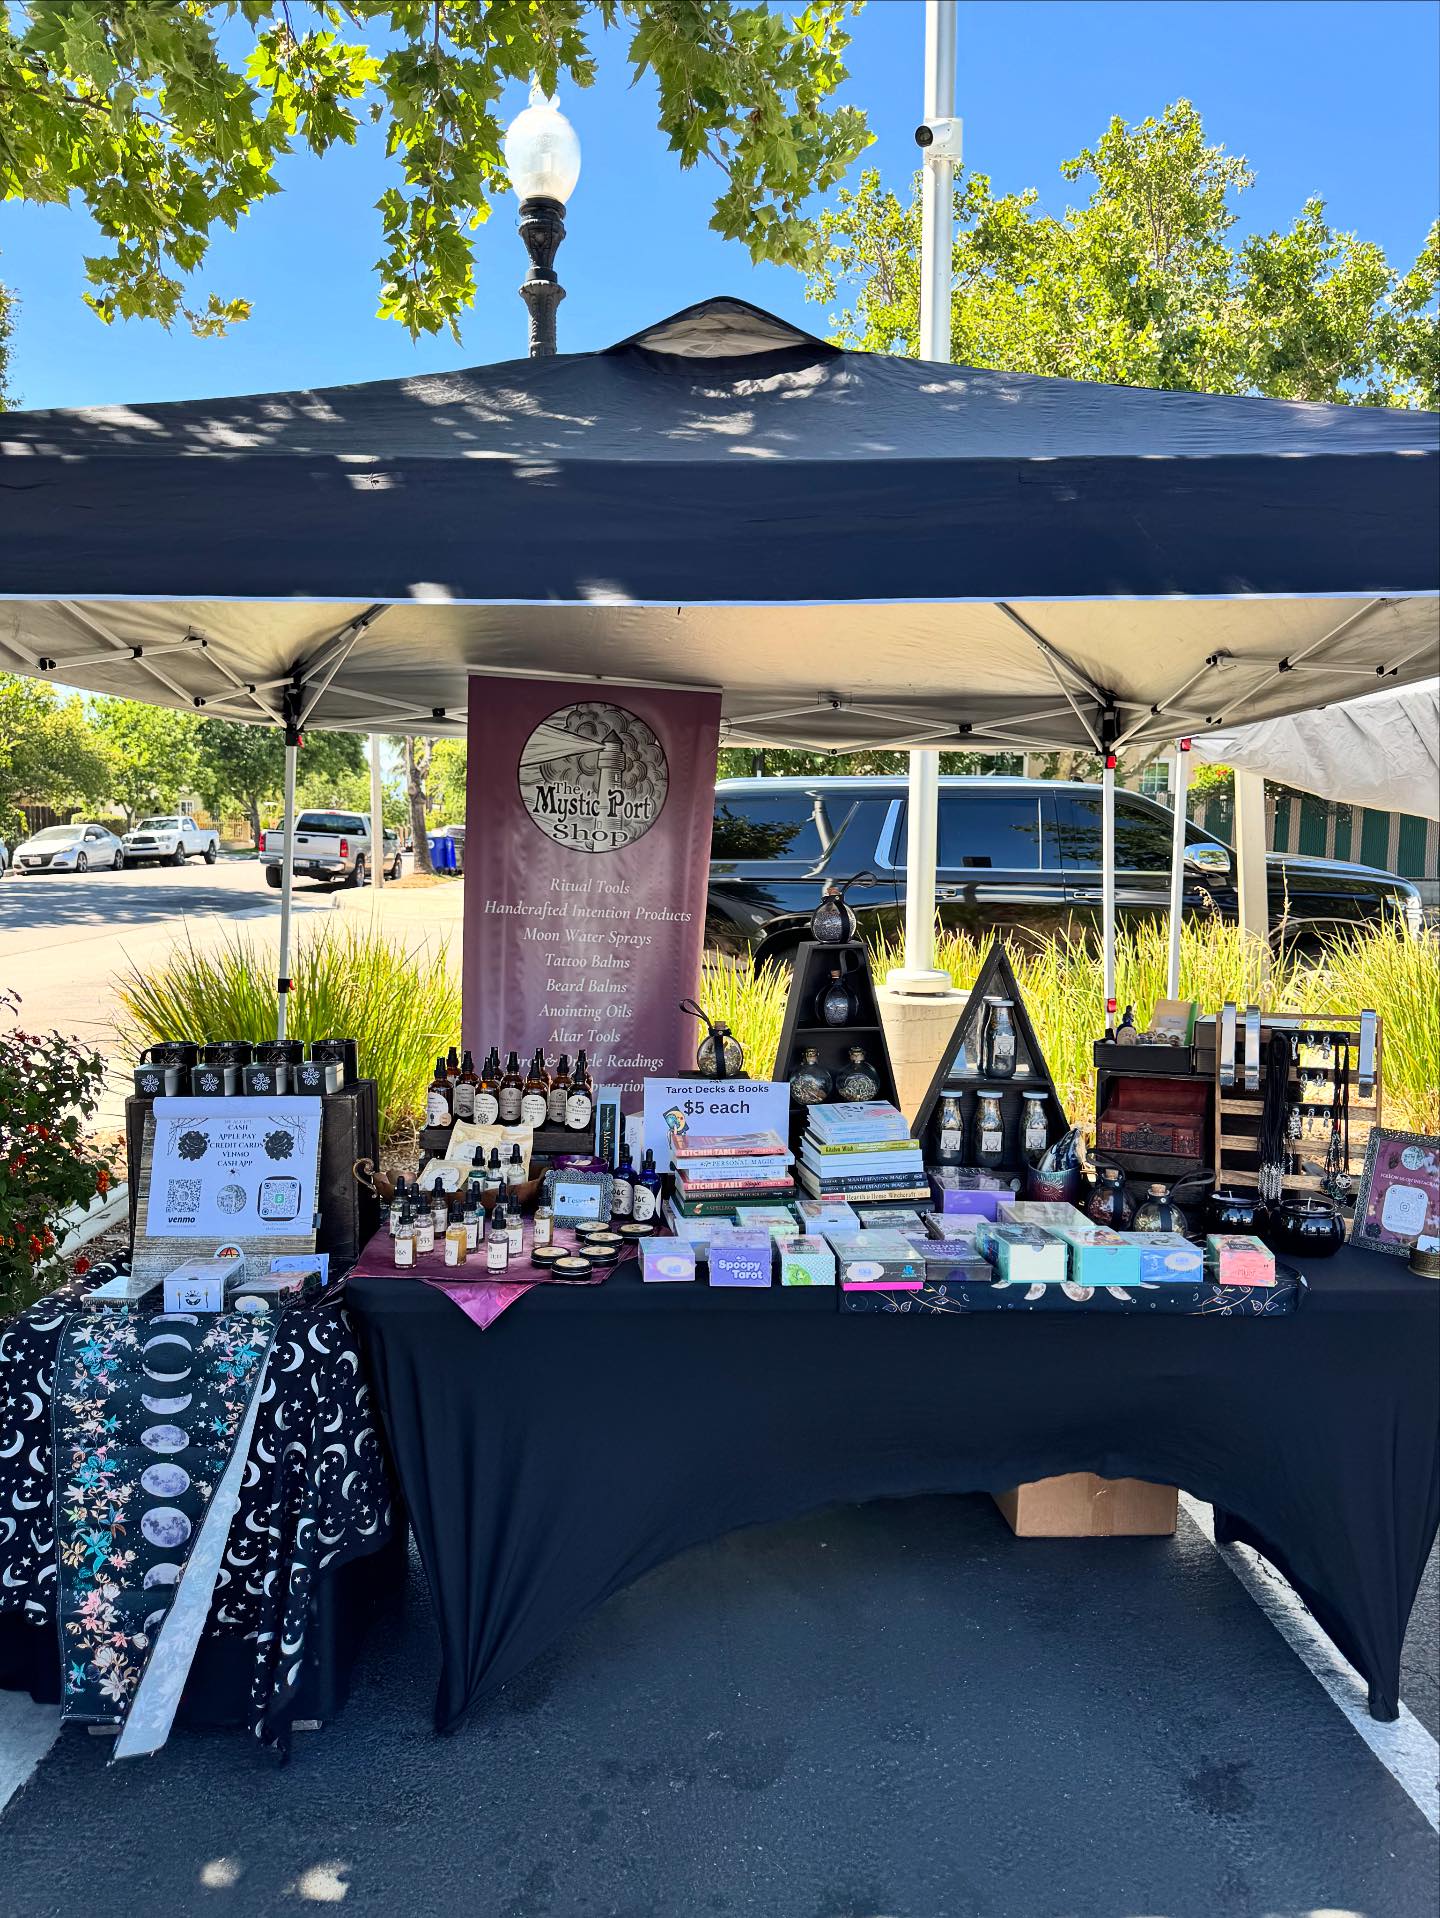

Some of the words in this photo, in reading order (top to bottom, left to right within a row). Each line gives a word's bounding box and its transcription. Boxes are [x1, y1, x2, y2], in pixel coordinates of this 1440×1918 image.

[553, 782, 581, 795] The
[532, 784, 601, 823] Mystic
[606, 789, 652, 821] Port
[552, 823, 629, 847] Shop
[550, 877, 593, 893] Ritual
[597, 880, 631, 895] Tools
[484, 900, 568, 920] Handcrafted
[572, 903, 631, 920] Intention
[635, 906, 692, 922] Products
[523, 927, 560, 942] Moon
[565, 929, 605, 943] Water
[608, 930, 652, 949] Sprays
[544, 953, 587, 968] Tattoo
[591, 953, 631, 969] Balms
[546, 978, 584, 993] Beard
[588, 979, 627, 994] Balms
[538, 1004, 602, 1021] Anointing
[606, 1004, 633, 1018] Oils
[549, 1029, 584, 1042] Altar
[588, 1029, 621, 1042] Tools
[544, 1054, 559, 1068] &
[607, 1053, 664, 1071] Readings
[666, 1086, 693, 1094] Tarot
[695, 1085, 726, 1094] Decks
[728, 1085, 736, 1093] &
[738, 1084, 769, 1093] Books
[684, 1100, 705, 1116] $5
[709, 1100, 750, 1115] each
[681, 1148, 713, 1157] KITCHEN
[714, 1148, 736, 1156] TABLE
[240, 1160, 253, 1168] APP
[712, 1159, 749, 1167] PERSONAL
[751, 1158, 775, 1166] MAGIC
[687, 1182, 720, 1190] KITCHEN
[720, 1181, 743, 1189] TABLE
[848, 1183, 890, 1191] MANIFESTATION
[891, 1181, 911, 1189] MAGIC
[846, 1193, 866, 1201] Hearth
[168, 1216, 196, 1224] venmo
[718, 1259, 762, 1272] Spoopy
[732, 1269, 764, 1280] Tarot
